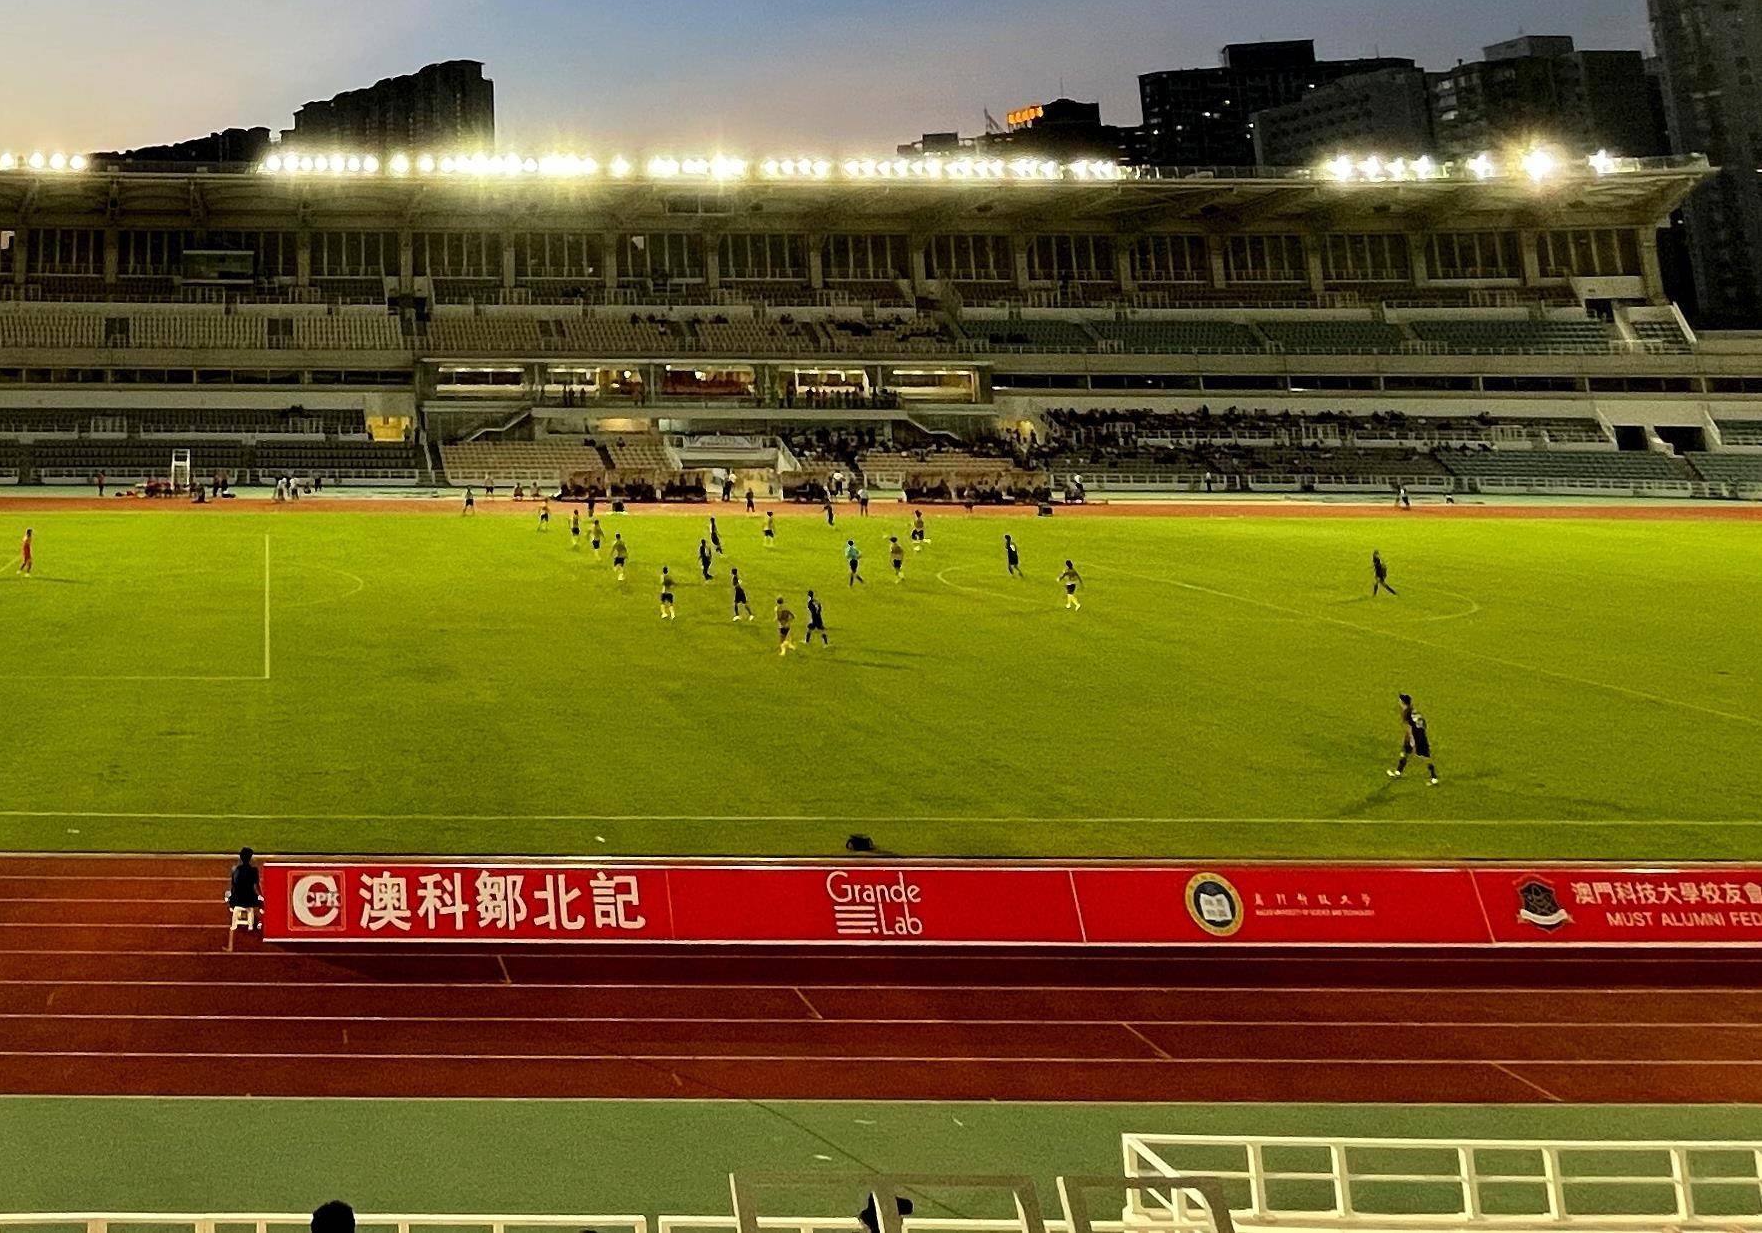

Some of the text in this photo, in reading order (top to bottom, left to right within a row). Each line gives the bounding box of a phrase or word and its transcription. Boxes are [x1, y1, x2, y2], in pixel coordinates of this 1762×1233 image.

[358, 870, 647, 932] 澳科鄒北記
[826, 870, 922, 903] Grande
[878, 901, 923, 935] Lab
[1605, 911, 1653, 927] MUST
[1660, 911, 1726, 927] ALUMNI
